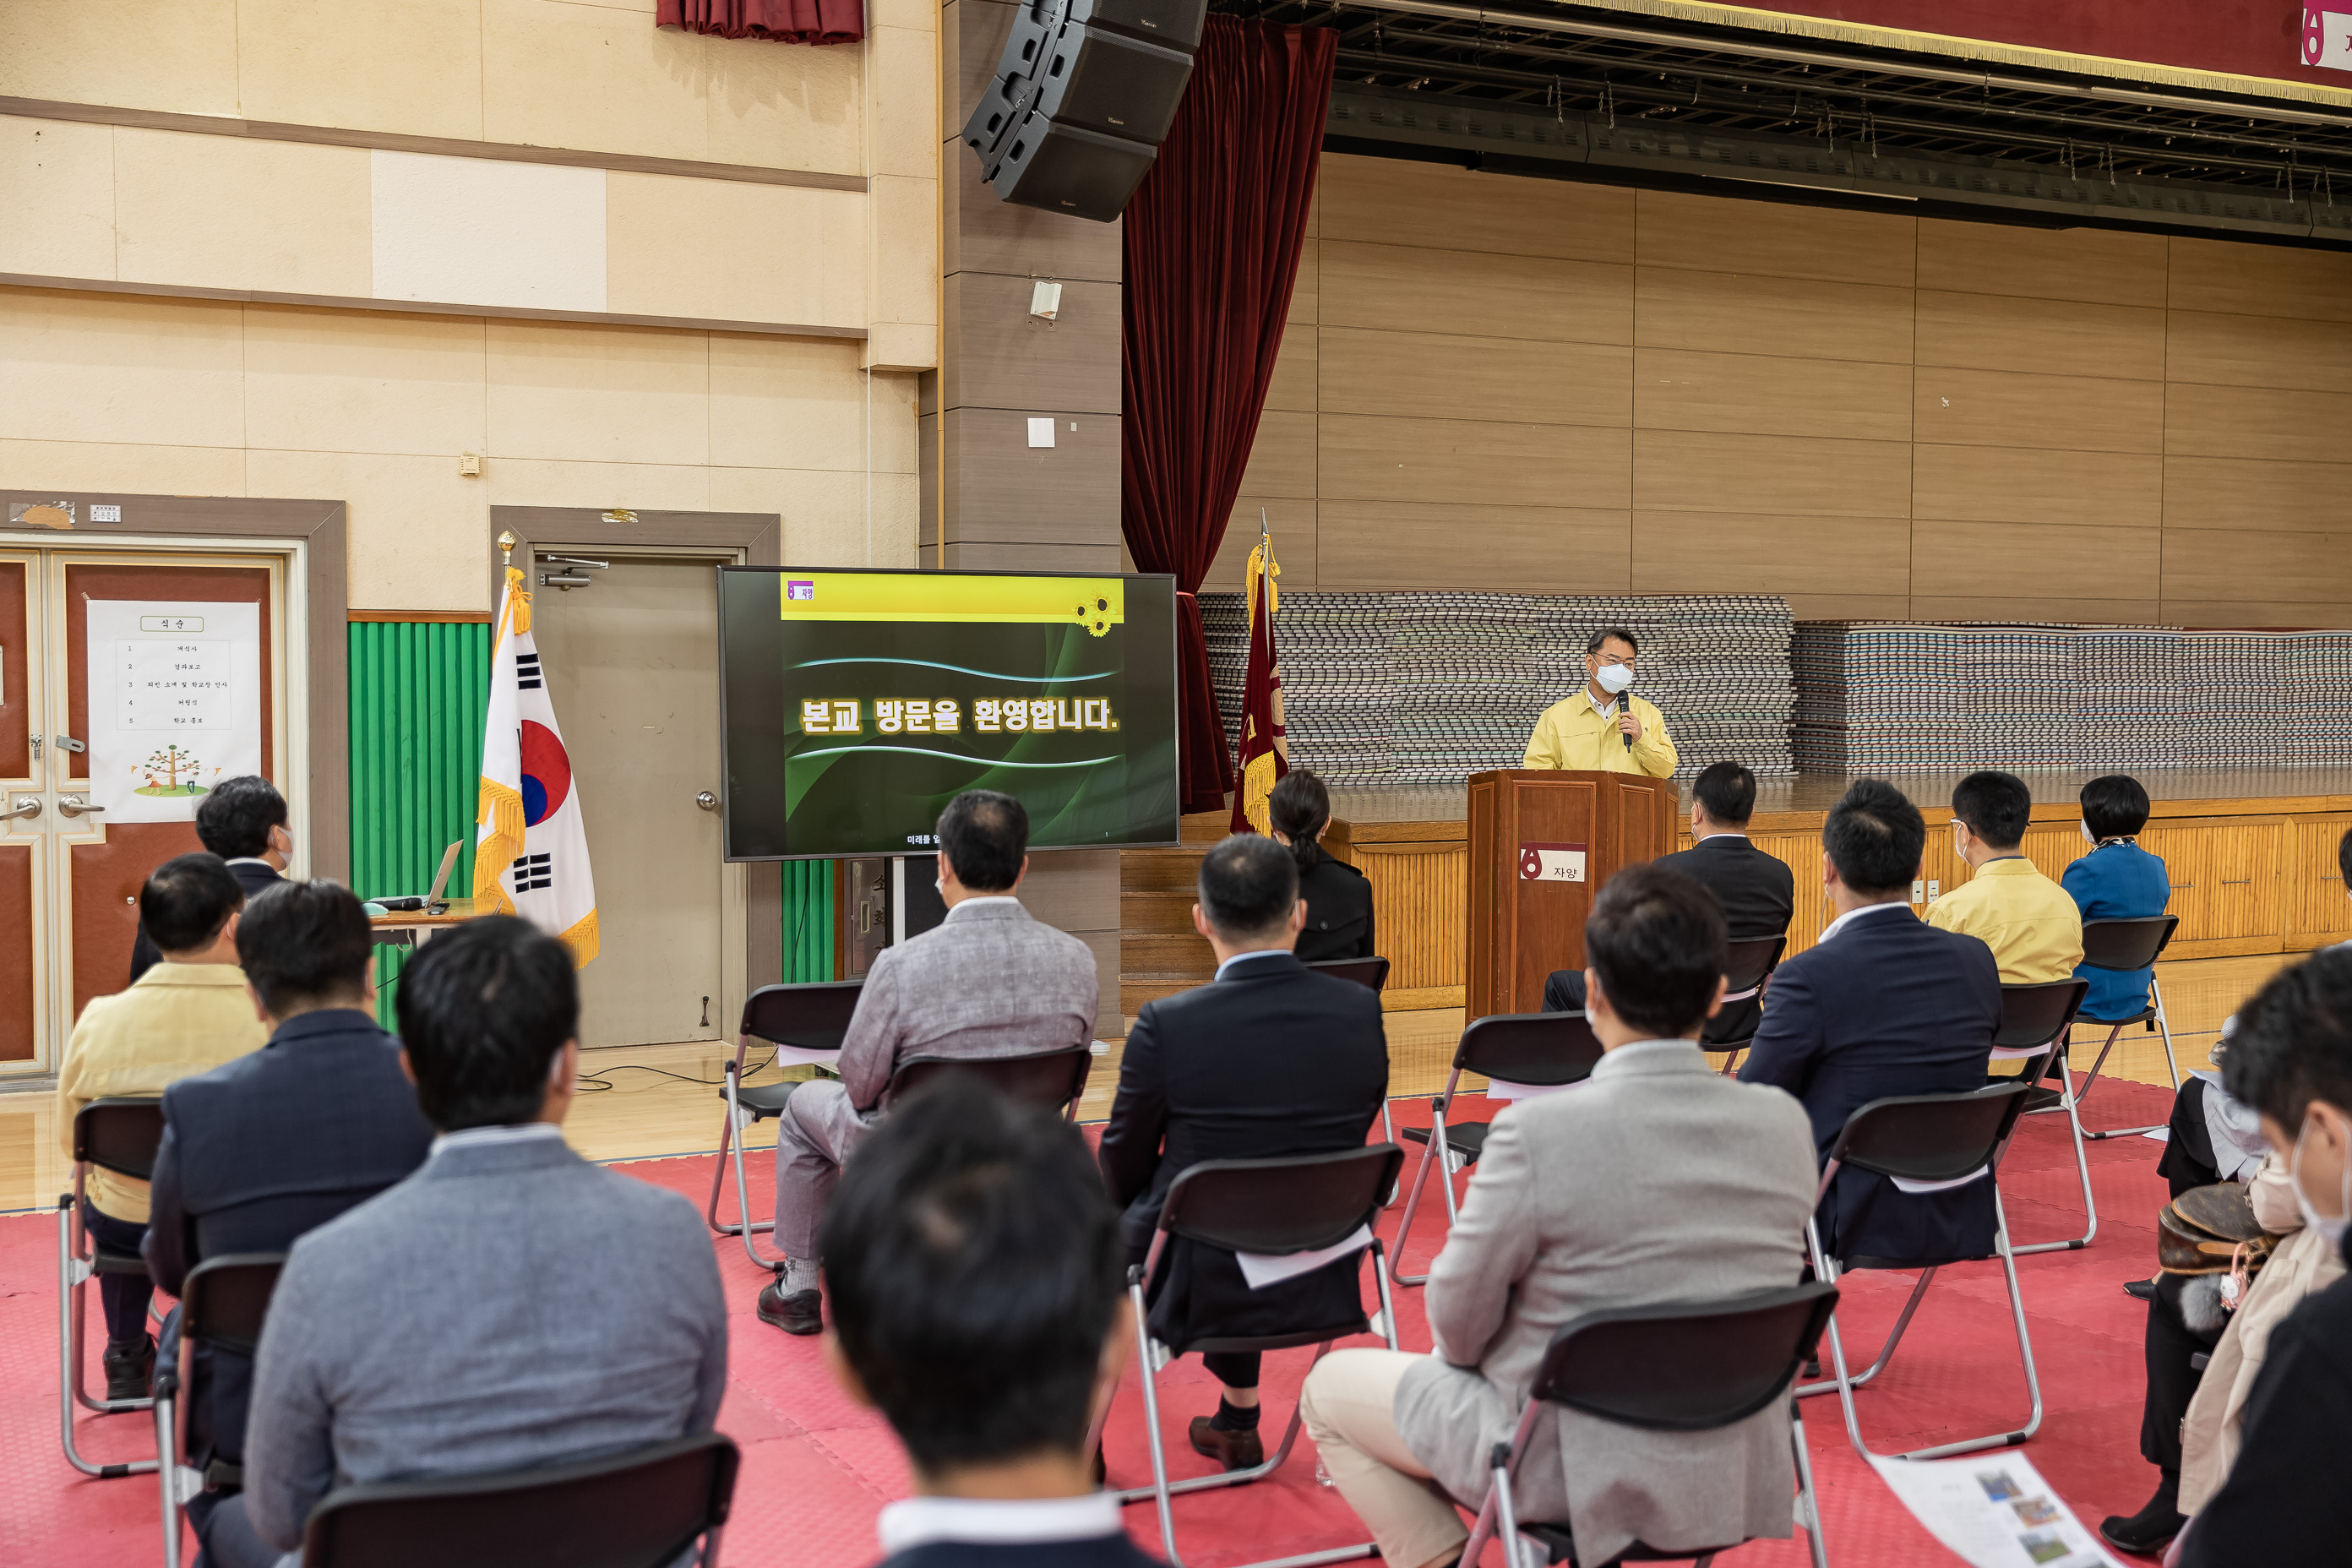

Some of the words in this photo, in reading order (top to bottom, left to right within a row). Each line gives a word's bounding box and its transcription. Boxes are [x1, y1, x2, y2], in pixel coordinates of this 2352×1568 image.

[802, 588, 813, 600] 자양
[161, 618, 169, 629] 식
[176, 619, 184, 629] 순
[803, 700, 860, 732] 본교
[876, 700, 960, 732] 방문을
[974, 698, 1119, 731] 환영합니다.
[906, 834, 931, 845] 미래를
[1554, 867, 1577, 879] 자양
